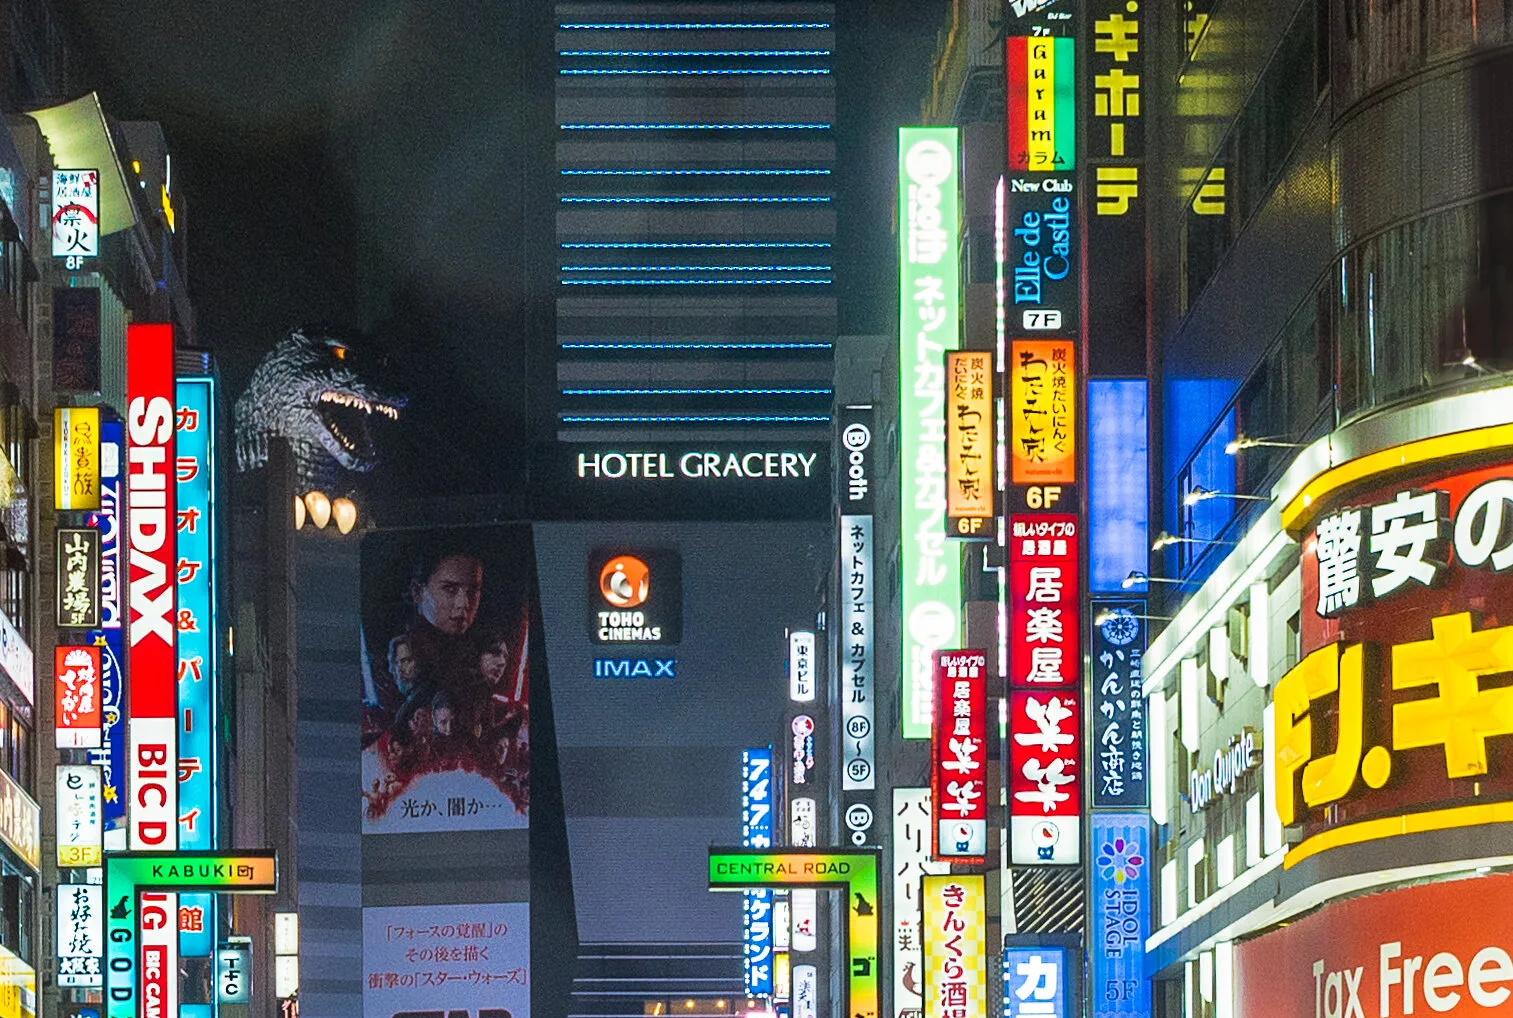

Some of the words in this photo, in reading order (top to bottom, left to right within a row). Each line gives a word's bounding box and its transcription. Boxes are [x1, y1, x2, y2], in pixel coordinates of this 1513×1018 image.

[1011, 178, 1041, 193] New
[1042, 178, 1073, 193] Club
[1014, 211, 1041, 246] de
[1043, 196, 1070, 281] Castle
[65, 256, 85, 270] 8F
[1014, 246, 1042, 305] Elle
[1028, 313, 1059, 326] 7F
[970, 356, 985, 400] 炭火焼
[577, 453, 673, 478] HOTEL
[680, 453, 817, 478] GRACERY
[843, 423, 871, 501] Booth
[1025, 485, 1063, 510] 6F
[128, 396, 174, 647] SHIDAX
[957, 518, 984, 534] 6F
[1316, 489, 1513, 616] 驚安の
[63, 532, 92, 614] 山内農場
[850, 524, 865, 614] ネットカフェ
[70, 613, 86, 625] 5F
[598, 611, 645, 628] TOHO
[598, 628, 661, 640] CINEMAS
[851, 622, 864, 635] &
[1025, 566, 1064, 685] 居楽屋
[594, 659, 675, 678] IMAX
[796, 646, 809, 695] 東京ビル
[850, 643, 865, 703] カプセル
[952, 680, 973, 736] 居楽屋
[1099, 649, 1126, 796] かんかん商店
[851, 722, 866, 733] 8F
[137, 743, 167, 809] BIC
[851, 765, 866, 776] 5F
[1189, 766, 1214, 814] Don
[1212, 726, 1257, 796] Quijote
[749, 758, 770, 828] 747
[68, 848, 91, 862] 3F
[717, 863, 798, 875] CENTRAL
[803, 862, 851, 874] ROAD
[152, 863, 254, 880] KABUKI町
[387, 923, 508, 942] 「フォースの覚醒」の
[1104, 889, 1122, 958] STAGE
[1121, 889, 1139, 946] IDOL
[144, 949, 160, 980] BIC
[405, 946, 490, 963] その後を描く
[368, 970, 528, 989] 衝撃の「スター・ウォーズ」
[1105, 979, 1139, 1002] 5F
[1379, 941, 1513, 1018] Free
